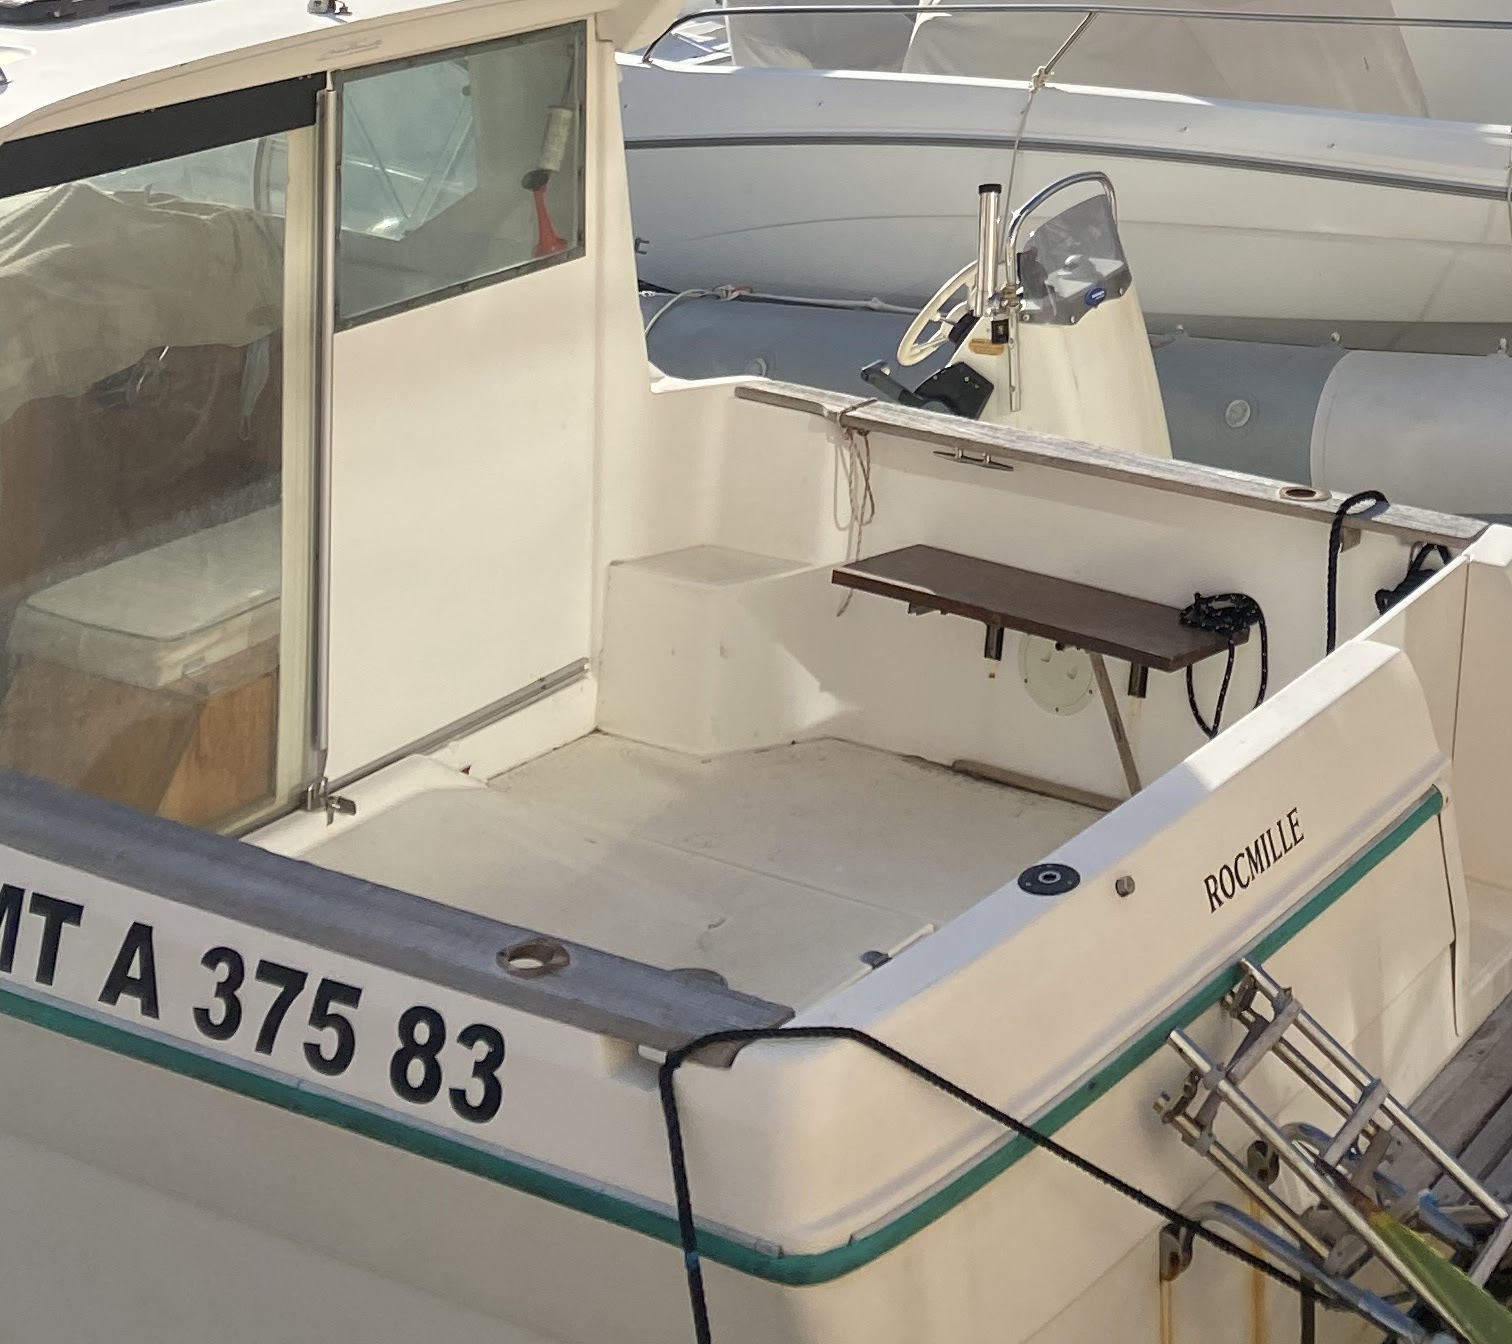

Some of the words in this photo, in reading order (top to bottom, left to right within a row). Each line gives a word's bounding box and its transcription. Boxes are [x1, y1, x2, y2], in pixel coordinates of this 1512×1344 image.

[1203, 806, 1305, 915] ROCMILLE
[98, 921, 160, 1020] A
[193, 946, 363, 1077] 375
[389, 1005, 506, 1124] 83
